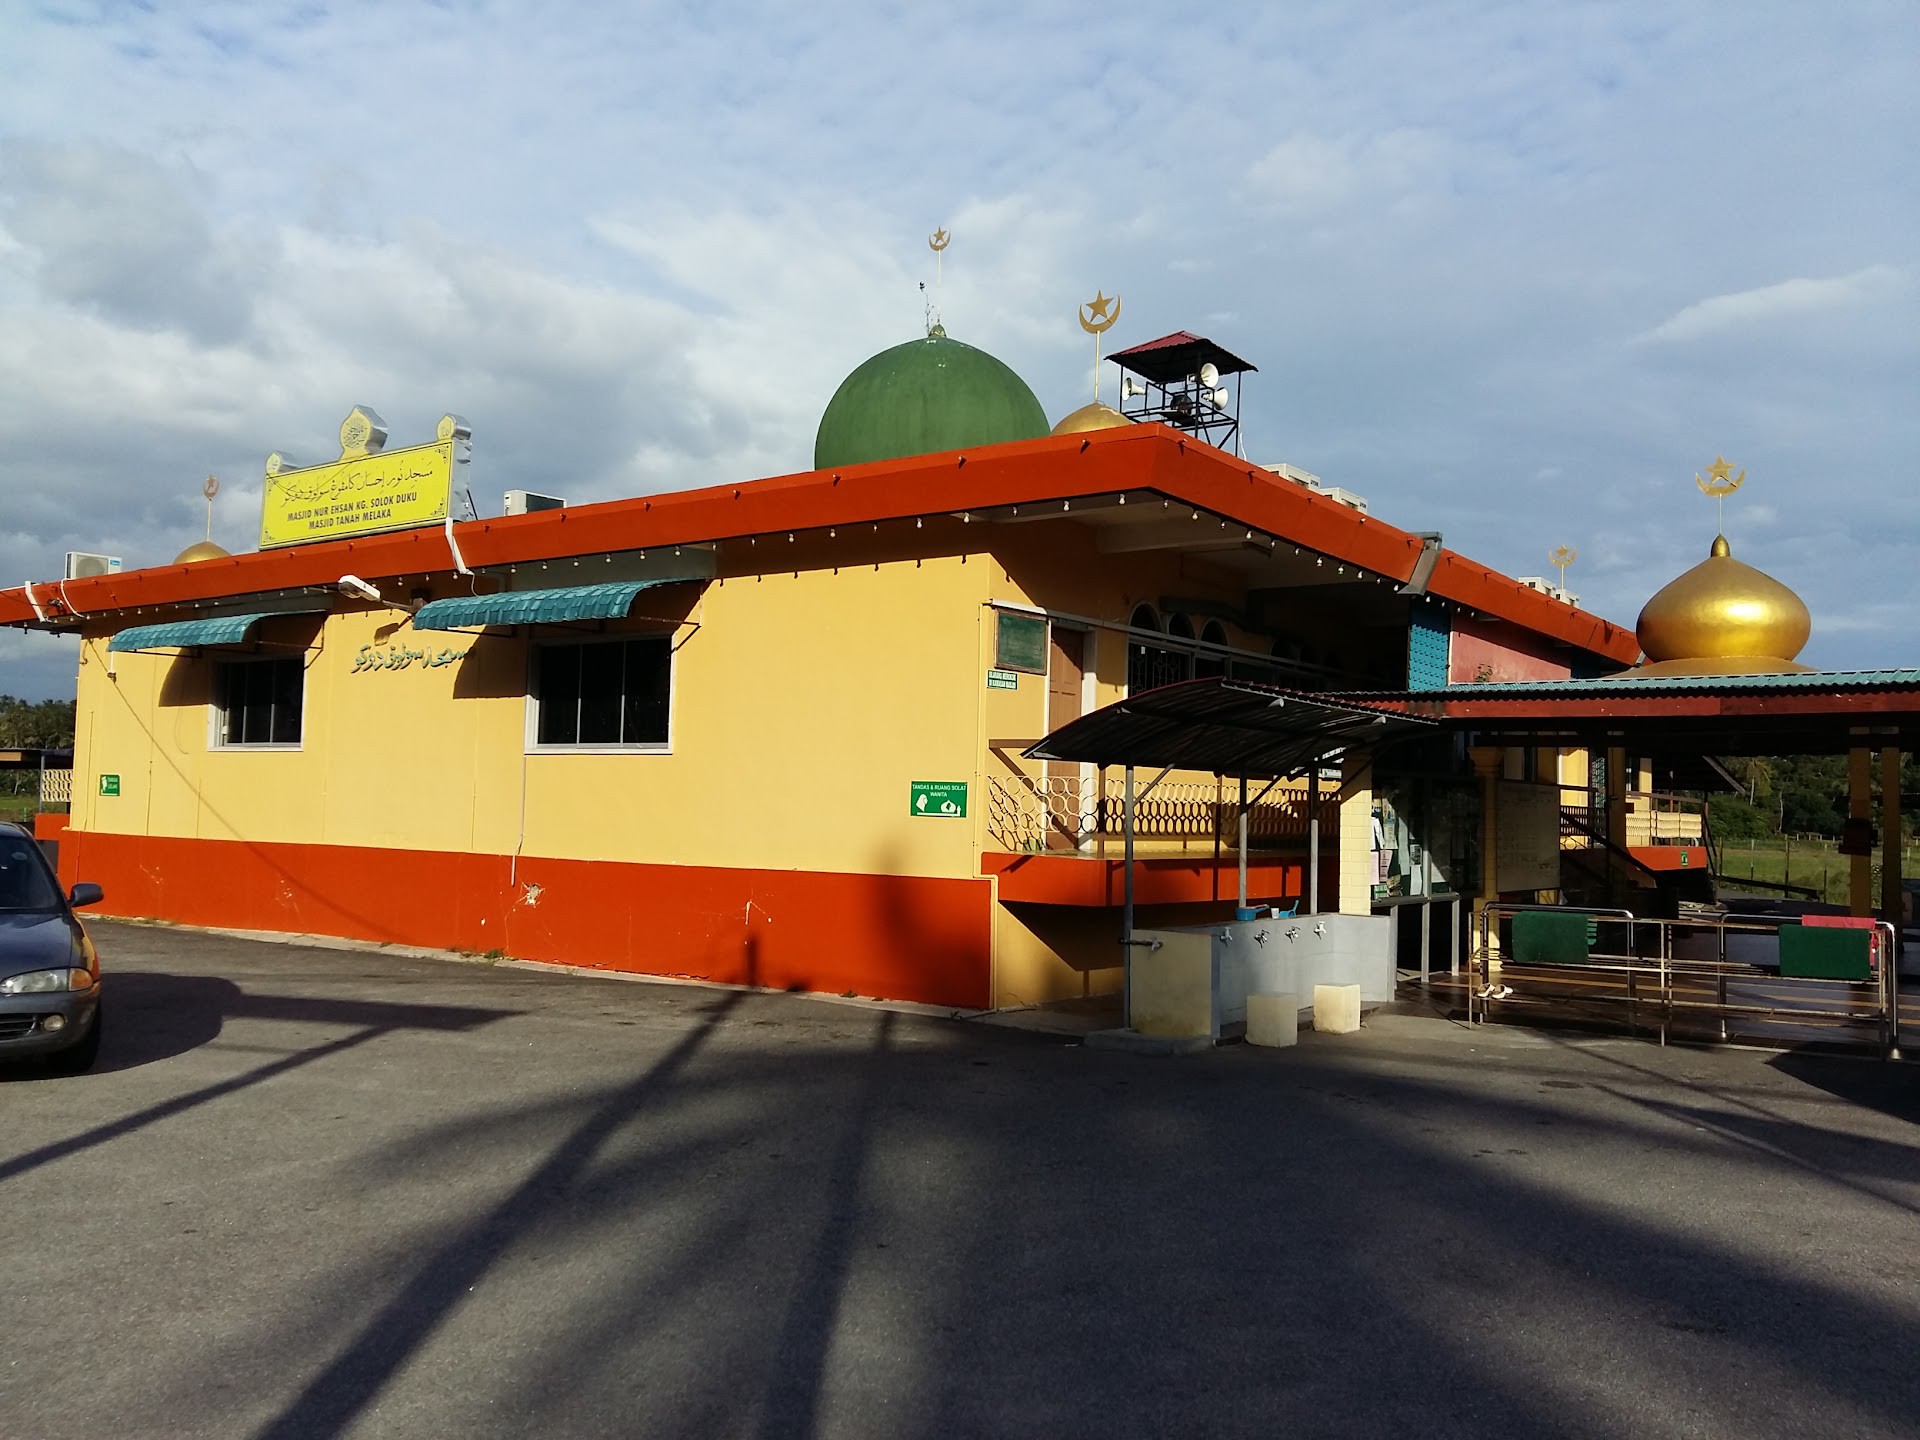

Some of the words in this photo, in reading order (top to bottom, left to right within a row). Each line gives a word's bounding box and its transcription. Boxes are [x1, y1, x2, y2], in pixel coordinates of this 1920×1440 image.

[287, 510, 312, 521] MASJID
[313, 506, 329, 517] NUR
[331, 503, 354, 514] EHSAN
[356, 500, 368, 510] KG.
[370, 496, 394, 508] SOLOK
[396, 492, 418, 503] DUKU
[308, 518, 334, 530] MASJID
[336, 513, 360, 525] TANAH
[362, 509, 392, 521] MELAKA
